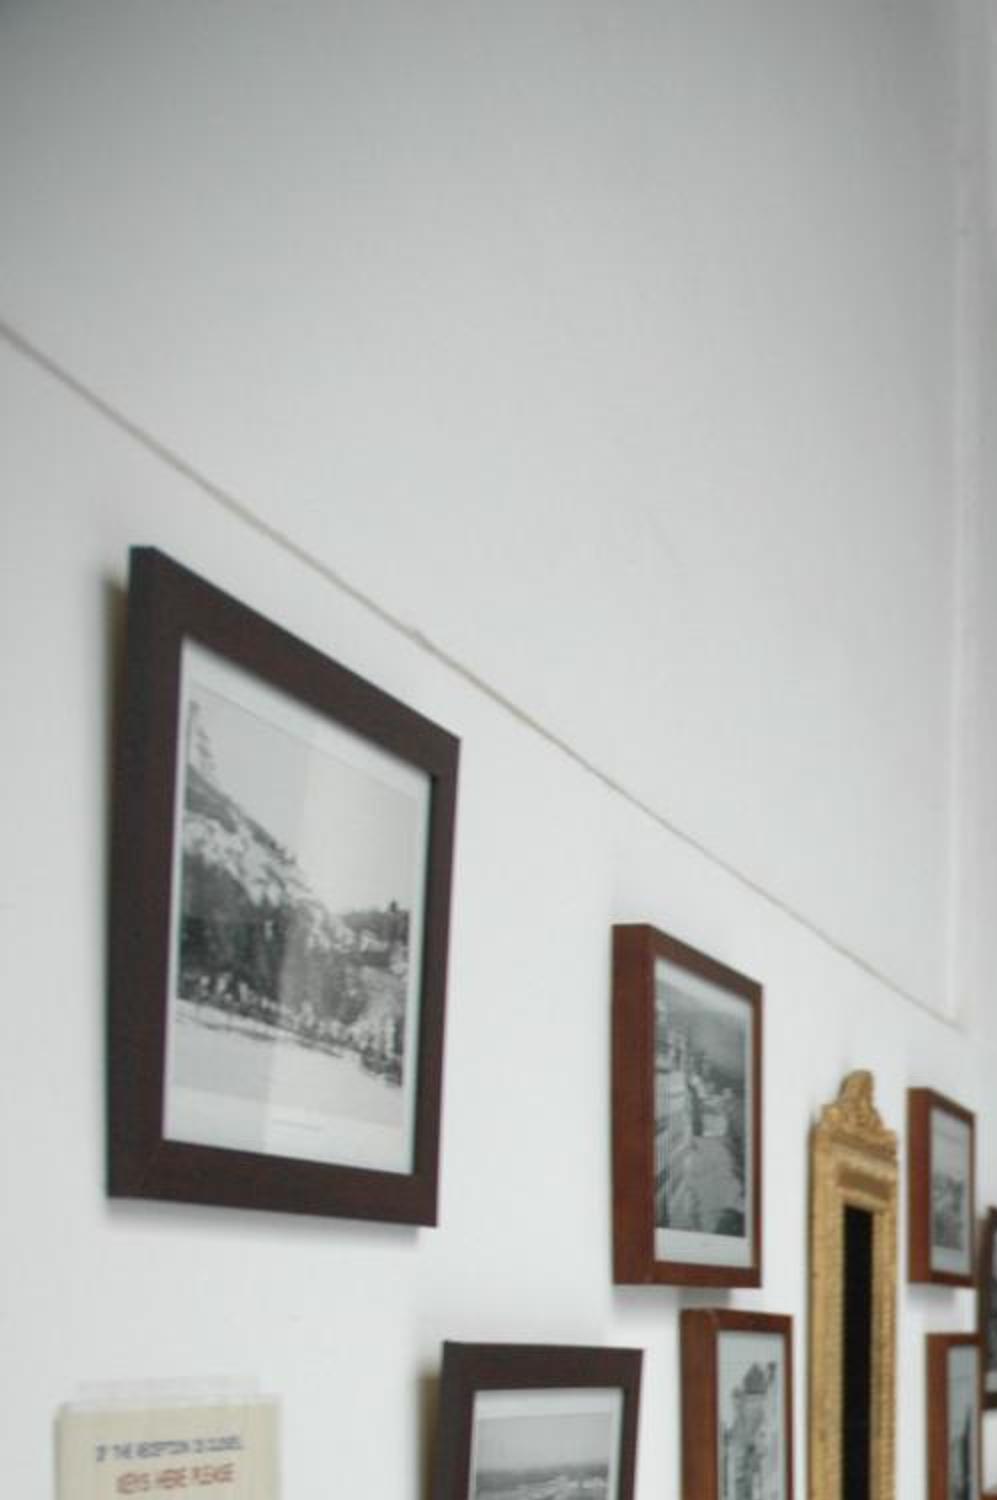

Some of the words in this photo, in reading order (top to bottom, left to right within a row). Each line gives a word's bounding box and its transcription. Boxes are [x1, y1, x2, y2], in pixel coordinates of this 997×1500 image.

[112, 1441, 132, 1460] THE
[115, 1471, 151, 1494] KEYS
[155, 1467, 188, 1489] HERE
[191, 1462, 235, 1486] PLEASE
